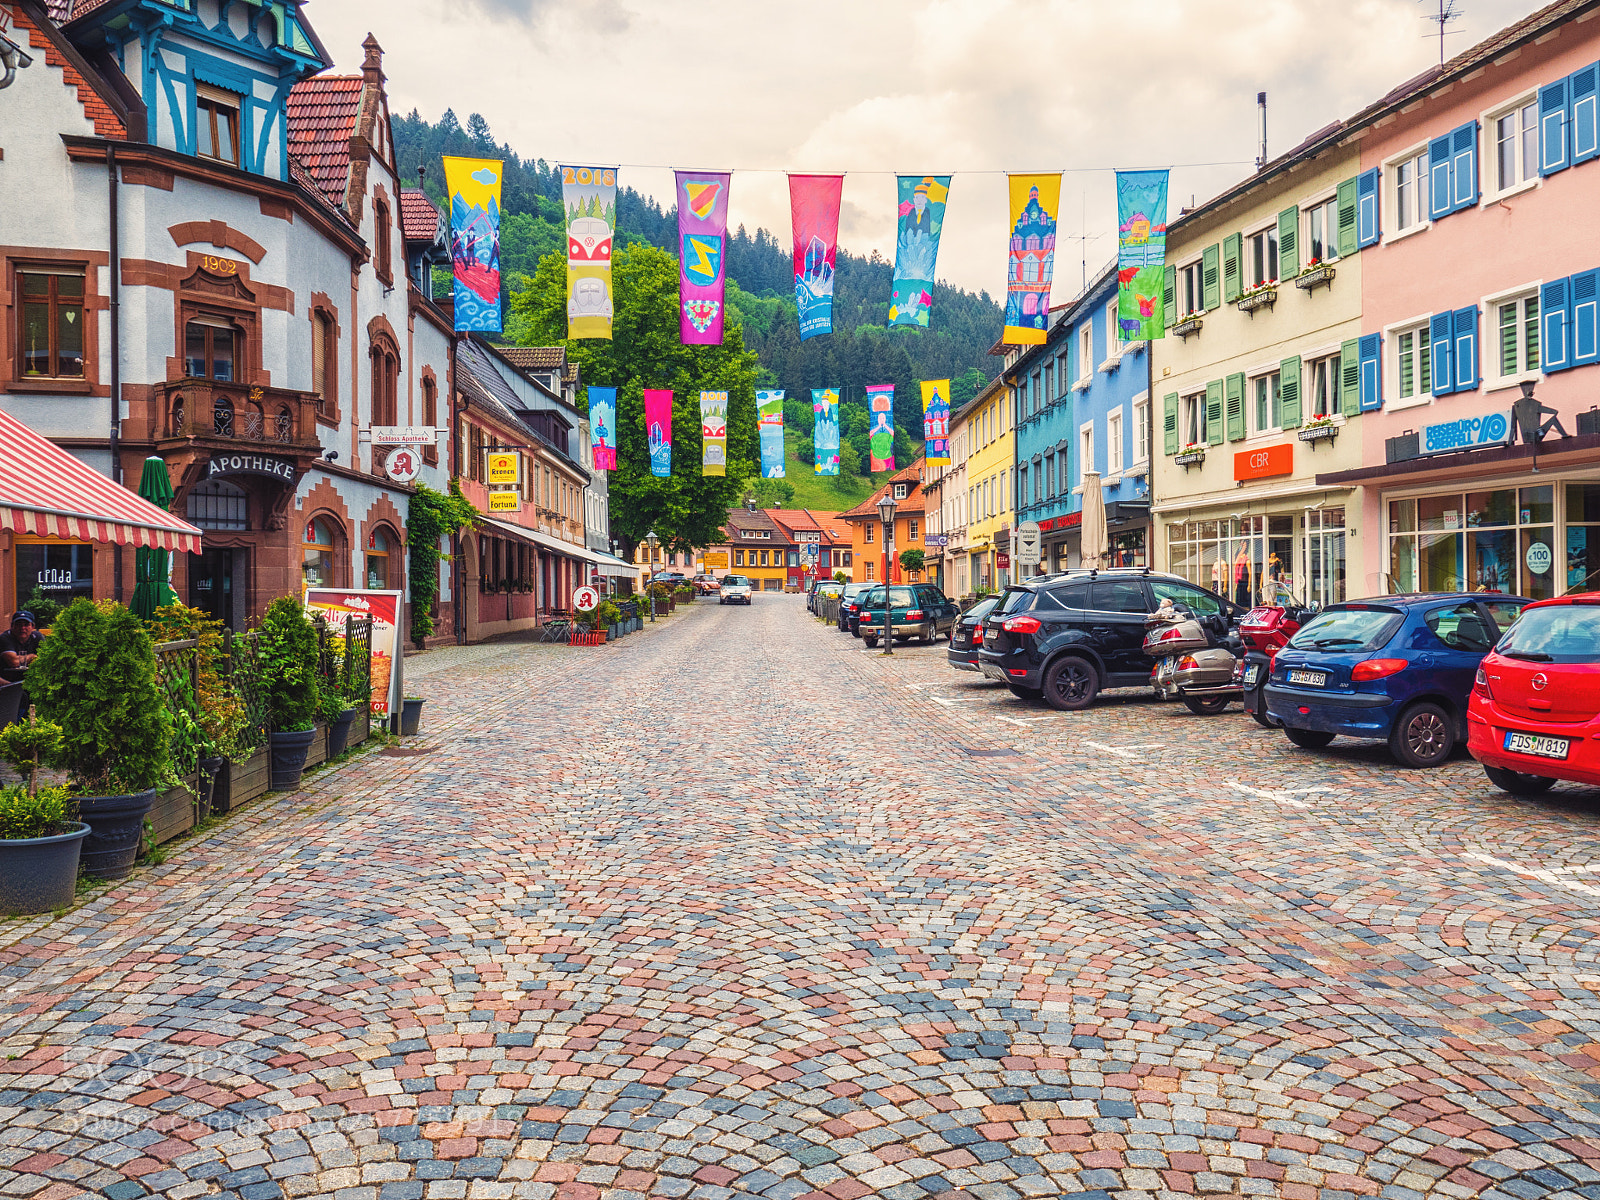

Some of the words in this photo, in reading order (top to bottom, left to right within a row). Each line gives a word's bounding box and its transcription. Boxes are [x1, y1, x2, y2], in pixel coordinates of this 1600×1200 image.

[562, 167, 616, 186] 2018
[202, 255, 237, 274] 1902
[700, 391, 727, 401] 2018
[1426, 418, 1481, 439] REISEBÜRO
[401, 435, 428, 443] Apotheke
[1426, 431, 1474, 451] OBERFELL
[209, 455, 294, 479] APOTHEKE
[1249, 452, 1269, 468] CBR
[1528, 550, 1548, 561] €100
[323, 607, 339, 622] Ali
[1510, 734, 1531, 749] FDS
[1536, 738, 1546, 751] M
[1546, 739, 1567, 754] 819
